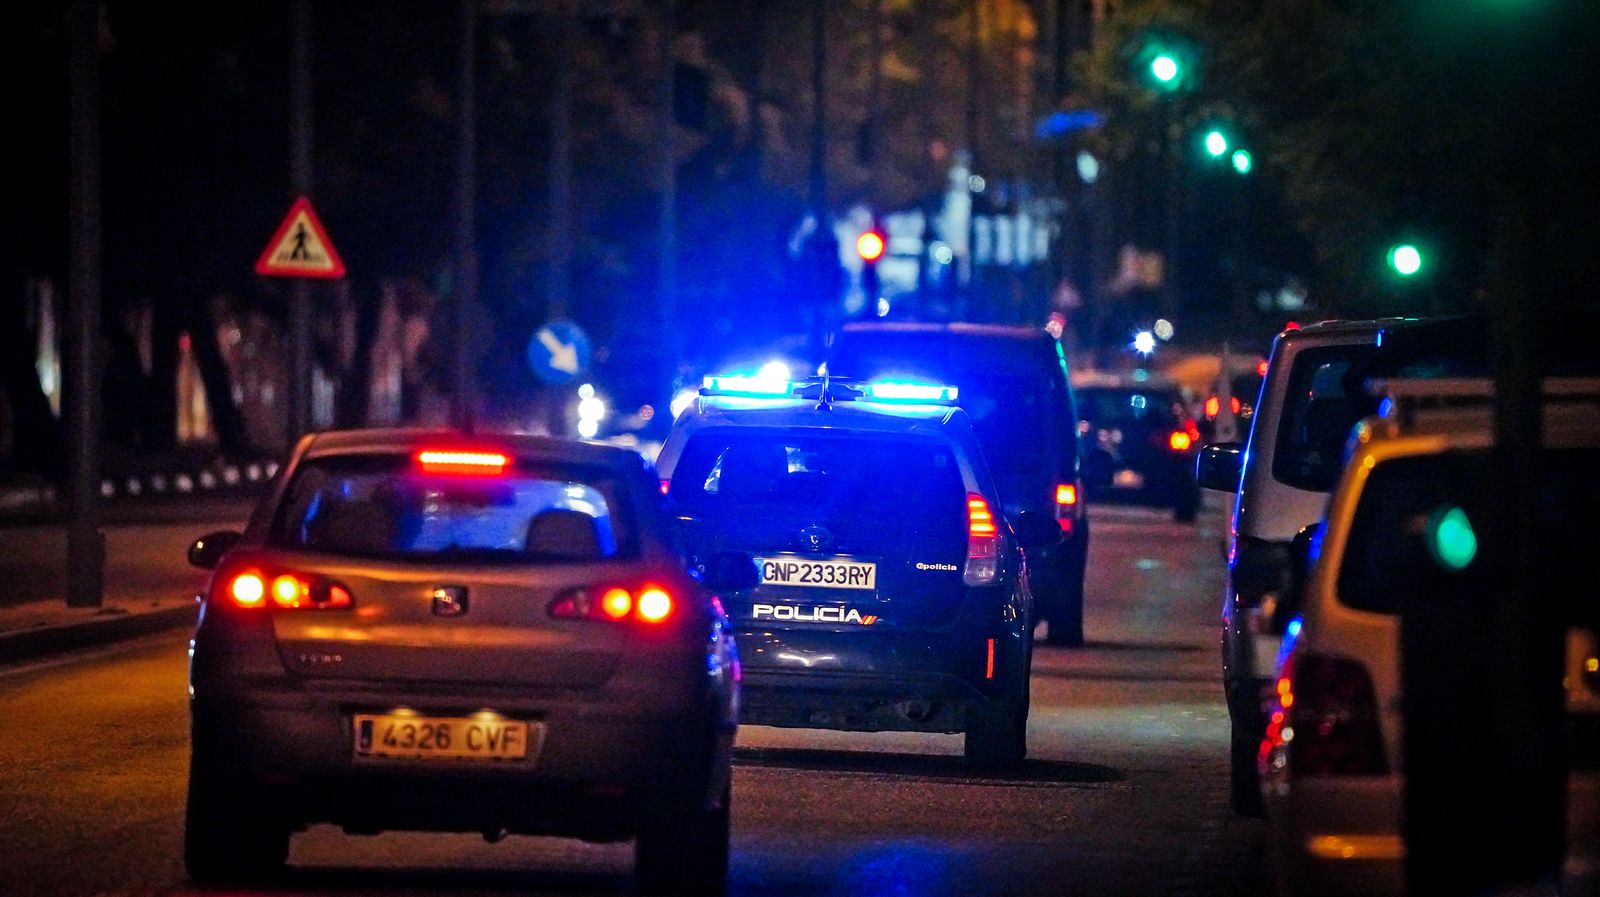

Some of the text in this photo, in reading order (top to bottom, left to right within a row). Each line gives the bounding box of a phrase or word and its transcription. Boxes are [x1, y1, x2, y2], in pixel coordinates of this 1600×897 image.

[753, 604, 863, 623] POLICÍA
[382, 723, 521, 752] 4326 CVF
